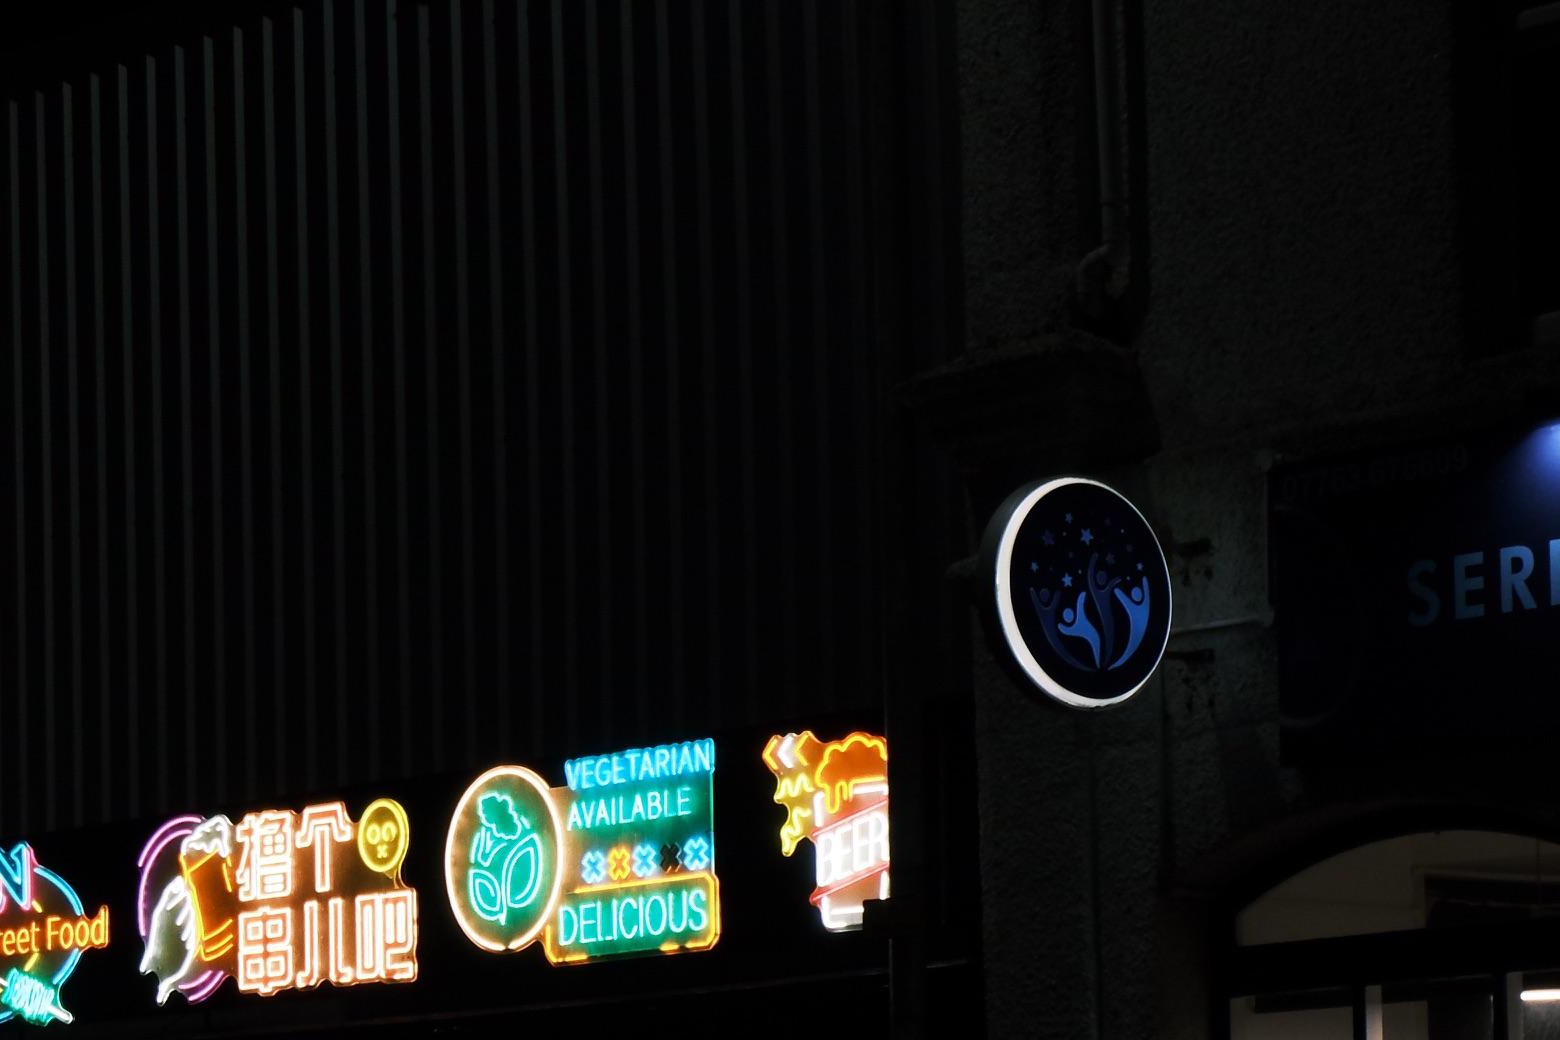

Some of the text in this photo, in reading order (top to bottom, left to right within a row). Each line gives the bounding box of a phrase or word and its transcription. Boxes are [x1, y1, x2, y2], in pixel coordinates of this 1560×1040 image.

[565, 740, 715, 790] VEGETARIAN
[567, 788, 693, 831] AVAILABLE
[816, 813, 889, 887] BEER
[45, 905, 109, 949] Food
[557, 890, 708, 946] DELICIOUS
